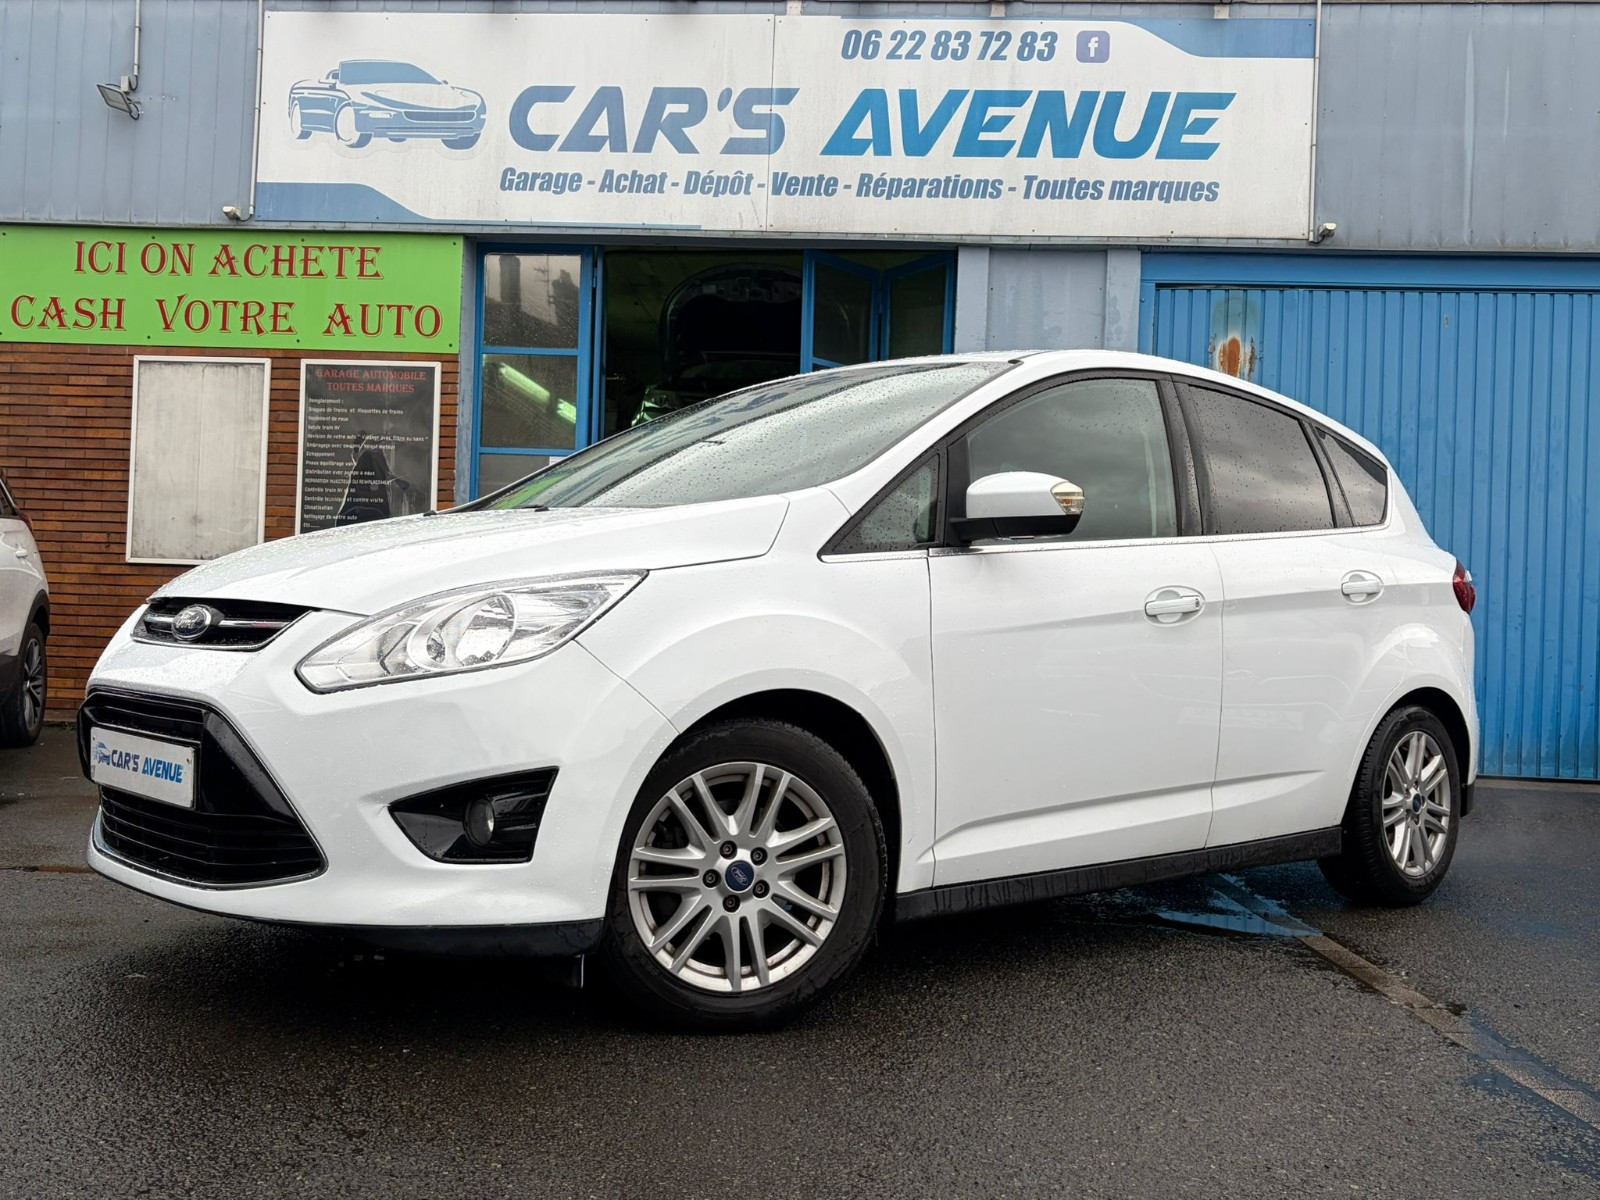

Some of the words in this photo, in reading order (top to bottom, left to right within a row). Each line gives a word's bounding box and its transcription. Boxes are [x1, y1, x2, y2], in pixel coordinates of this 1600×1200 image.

[841, 29, 882, 60] 06
[885, 30, 926, 60] 22
[931, 30, 971, 61] 83
[976, 31, 1013, 61] 72
[1016, 31, 1058, 61] 83
[509, 85, 800, 155] CAR'S
[820, 88, 1237, 160] AVENUE
[500, 167, 582, 195] Garage
[598, 169, 668, 194] Achat
[683, 170, 754, 198] Dépôt
[771, 172, 840, 197] Vente
[856, 172, 1003, 200] Réparations
[1023, 174, 1104, 200] Toutes
[1108, 179, 1220, 204] marques
[74, 241, 128, 275] ICI
[140, 242, 196, 276] ON
[208, 244, 384, 280] ACHETE
[11, 295, 127, 331] CASH
[156, 293, 297, 336] VOTRE
[322, 303, 443, 339] AUTO
[315, 369, 360, 379] GARAGE
[363, 370, 426, 380] AUTOMOBILE
[327, 382, 365, 392] TOUTES
[366, 383, 415, 393] MARQUES
[111, 749, 140, 772] CAR'S
[141, 757, 184, 784] AVENUE
